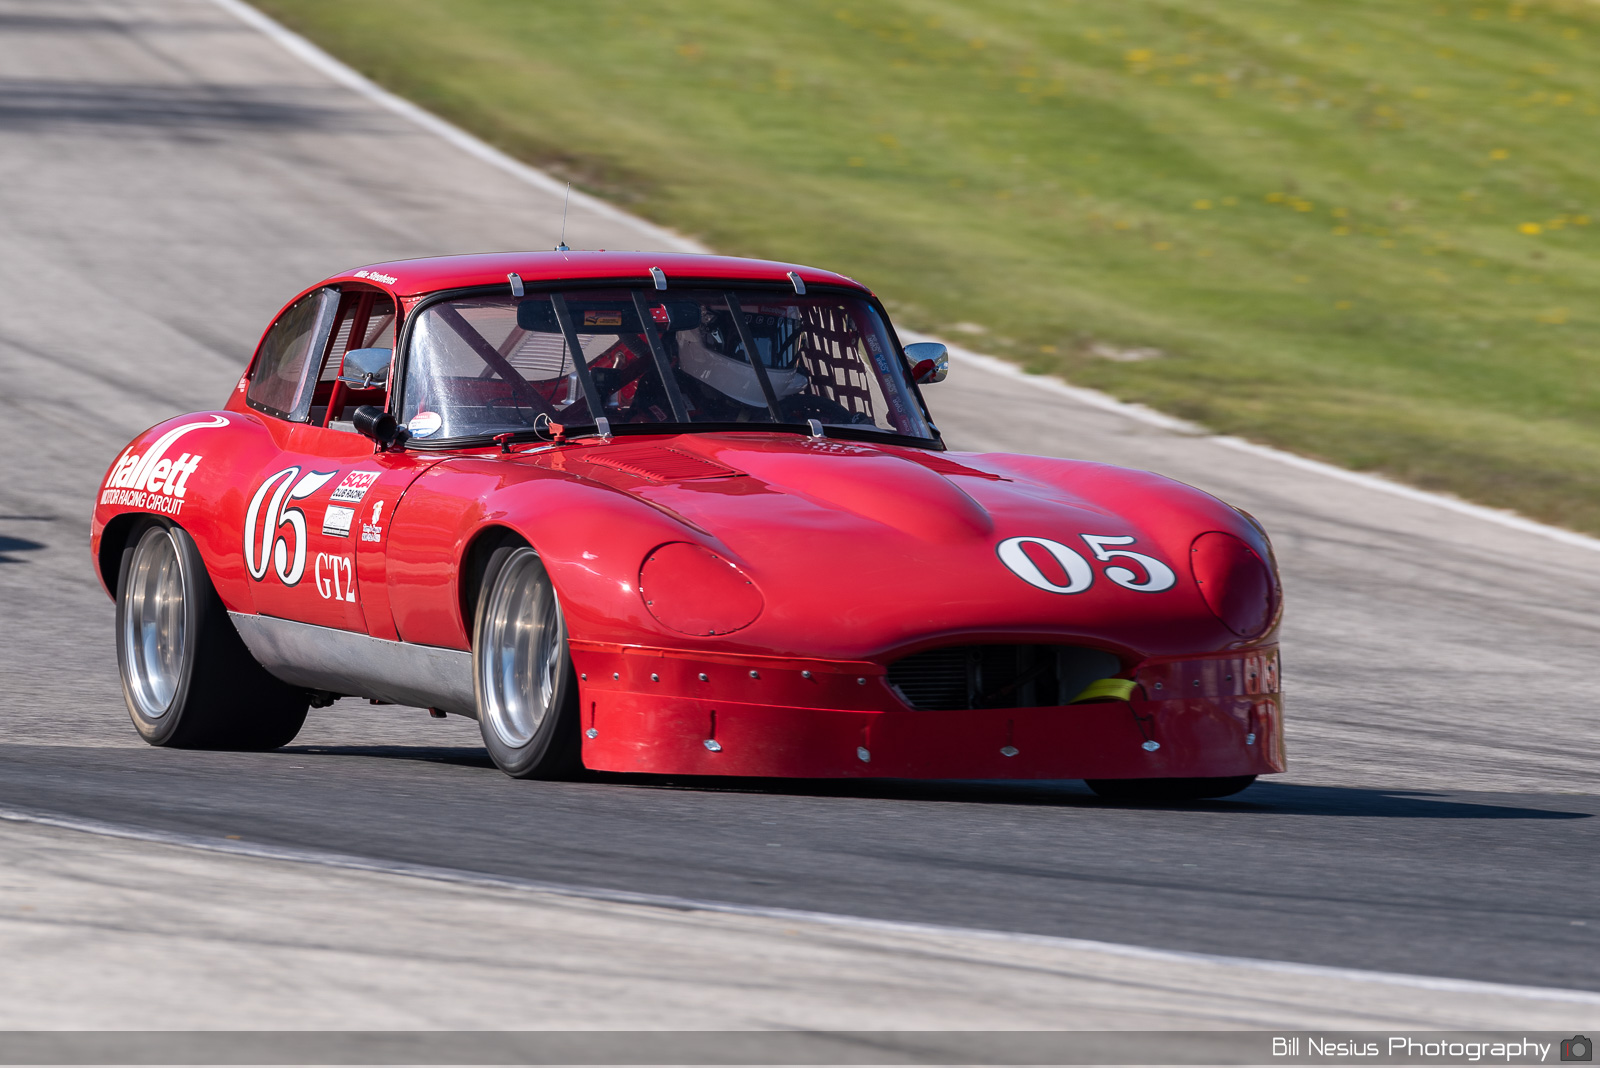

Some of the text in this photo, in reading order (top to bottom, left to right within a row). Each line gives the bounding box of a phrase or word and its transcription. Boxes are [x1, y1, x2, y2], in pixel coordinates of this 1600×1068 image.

[104, 411, 230, 498] hallett
[100, 489, 185, 515] MOTOR RACING CIRCUIT
[332, 488, 365, 499] CLUB RACING
[341, 473, 376, 488] SCCA
[244, 465, 339, 587] 05
[315, 552, 355, 603] GT2
[995, 533, 1178, 595] 05
